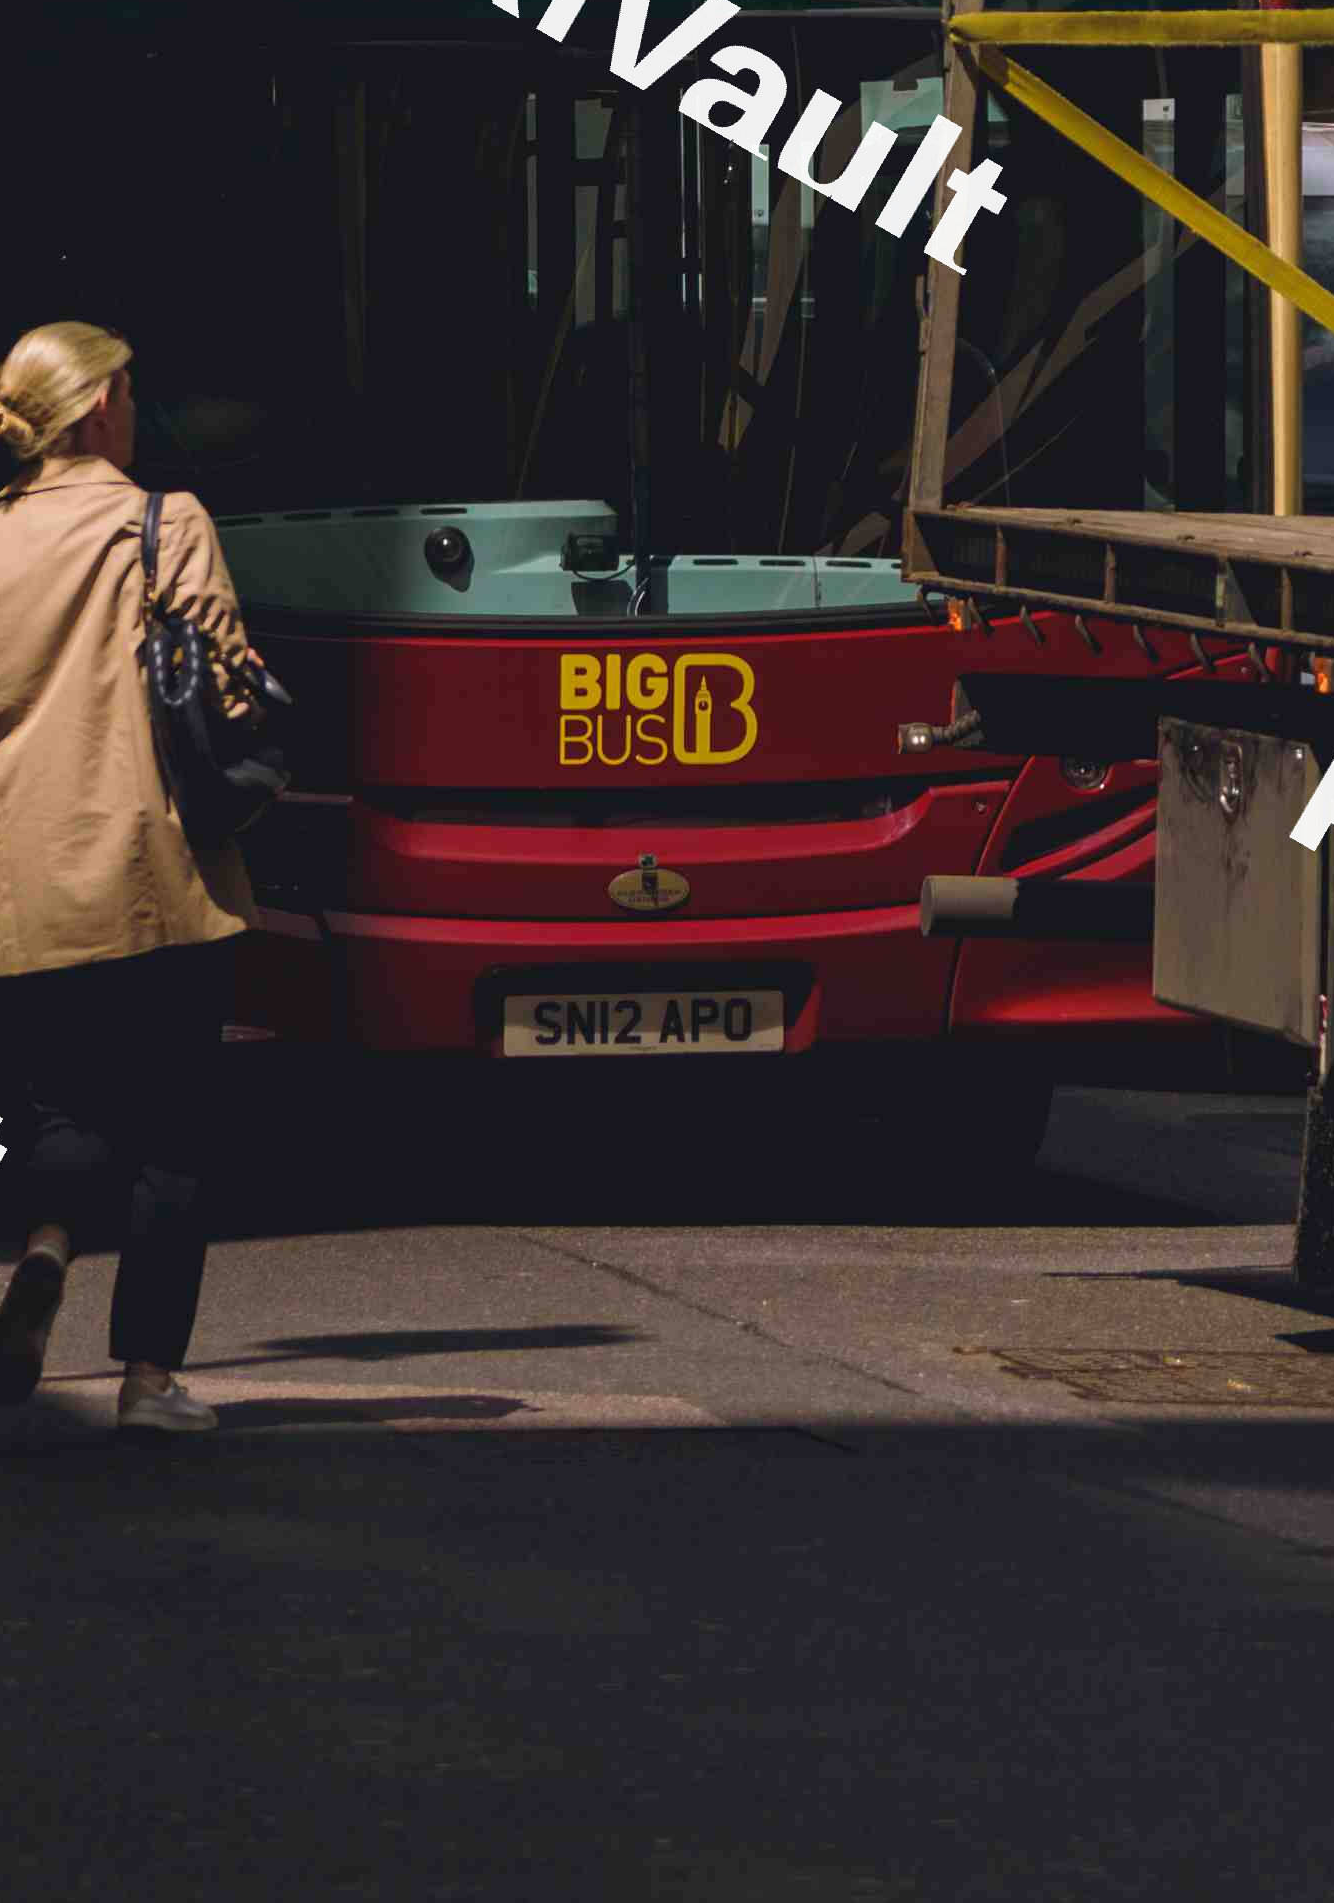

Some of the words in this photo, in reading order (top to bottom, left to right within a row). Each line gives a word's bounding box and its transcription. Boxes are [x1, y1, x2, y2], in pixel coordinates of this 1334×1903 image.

[559, 652, 668, 711] BIG
[559, 714, 668, 766] BUS
[534, 999, 642, 1045] SN12
[659, 997, 752, 1043] APO
